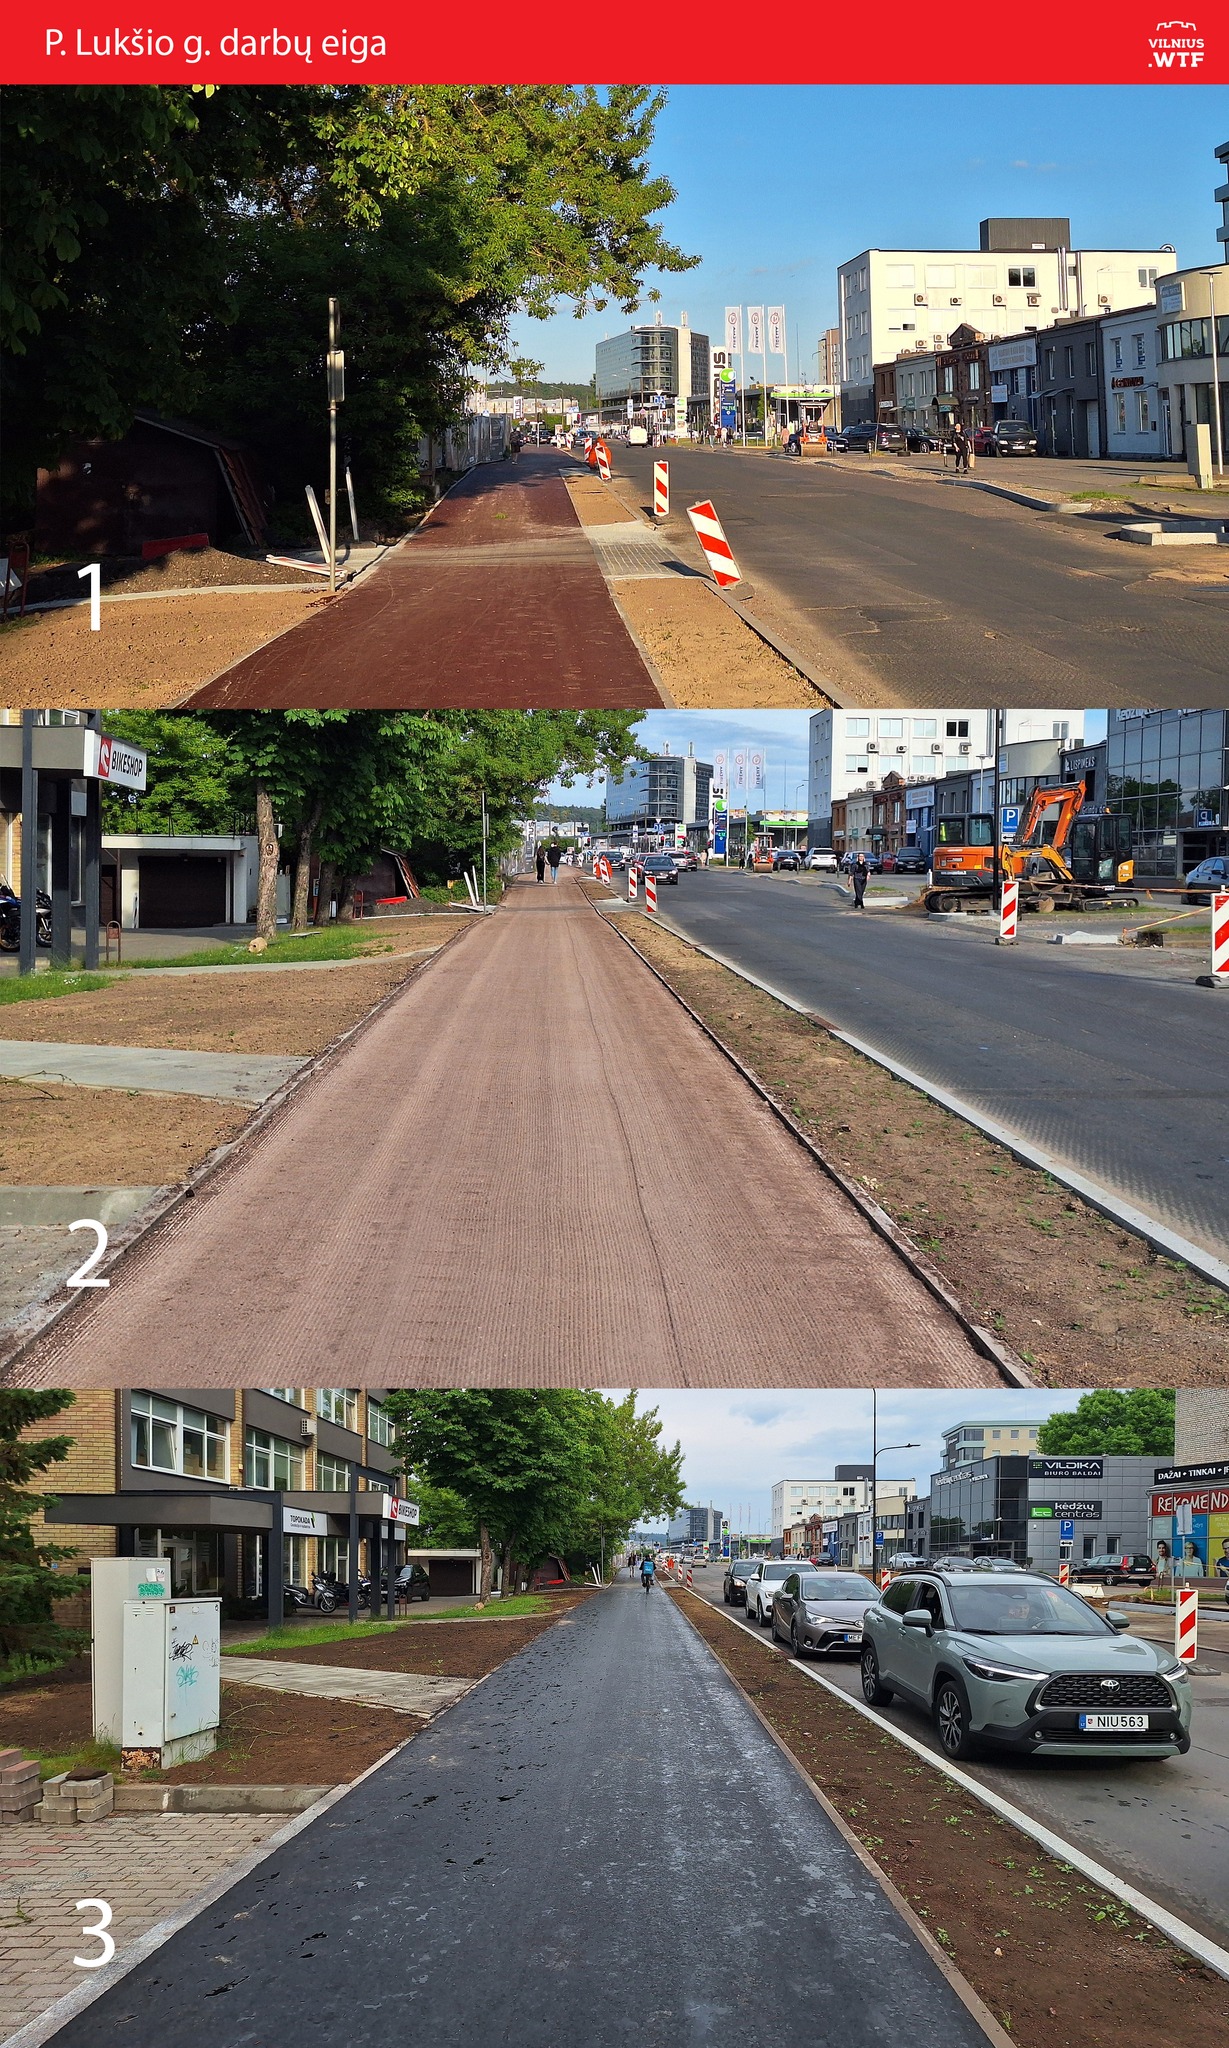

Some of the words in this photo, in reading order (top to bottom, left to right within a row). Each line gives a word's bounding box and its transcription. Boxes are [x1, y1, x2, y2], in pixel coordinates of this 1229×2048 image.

[111, 750, 143, 777] BIKESHOP
[1006, 809, 1016, 823] P
[1158, 1470, 1182, 1480] DAŽAI
[1188, 1467, 1216, 1477] TINKAI
[1055, 1502, 1094, 1511] kėdžių
[290, 1514, 311, 1524] TOPOKADA
[1055, 1510, 1100, 1518] centras
[1063, 1521, 1072, 1532] P
